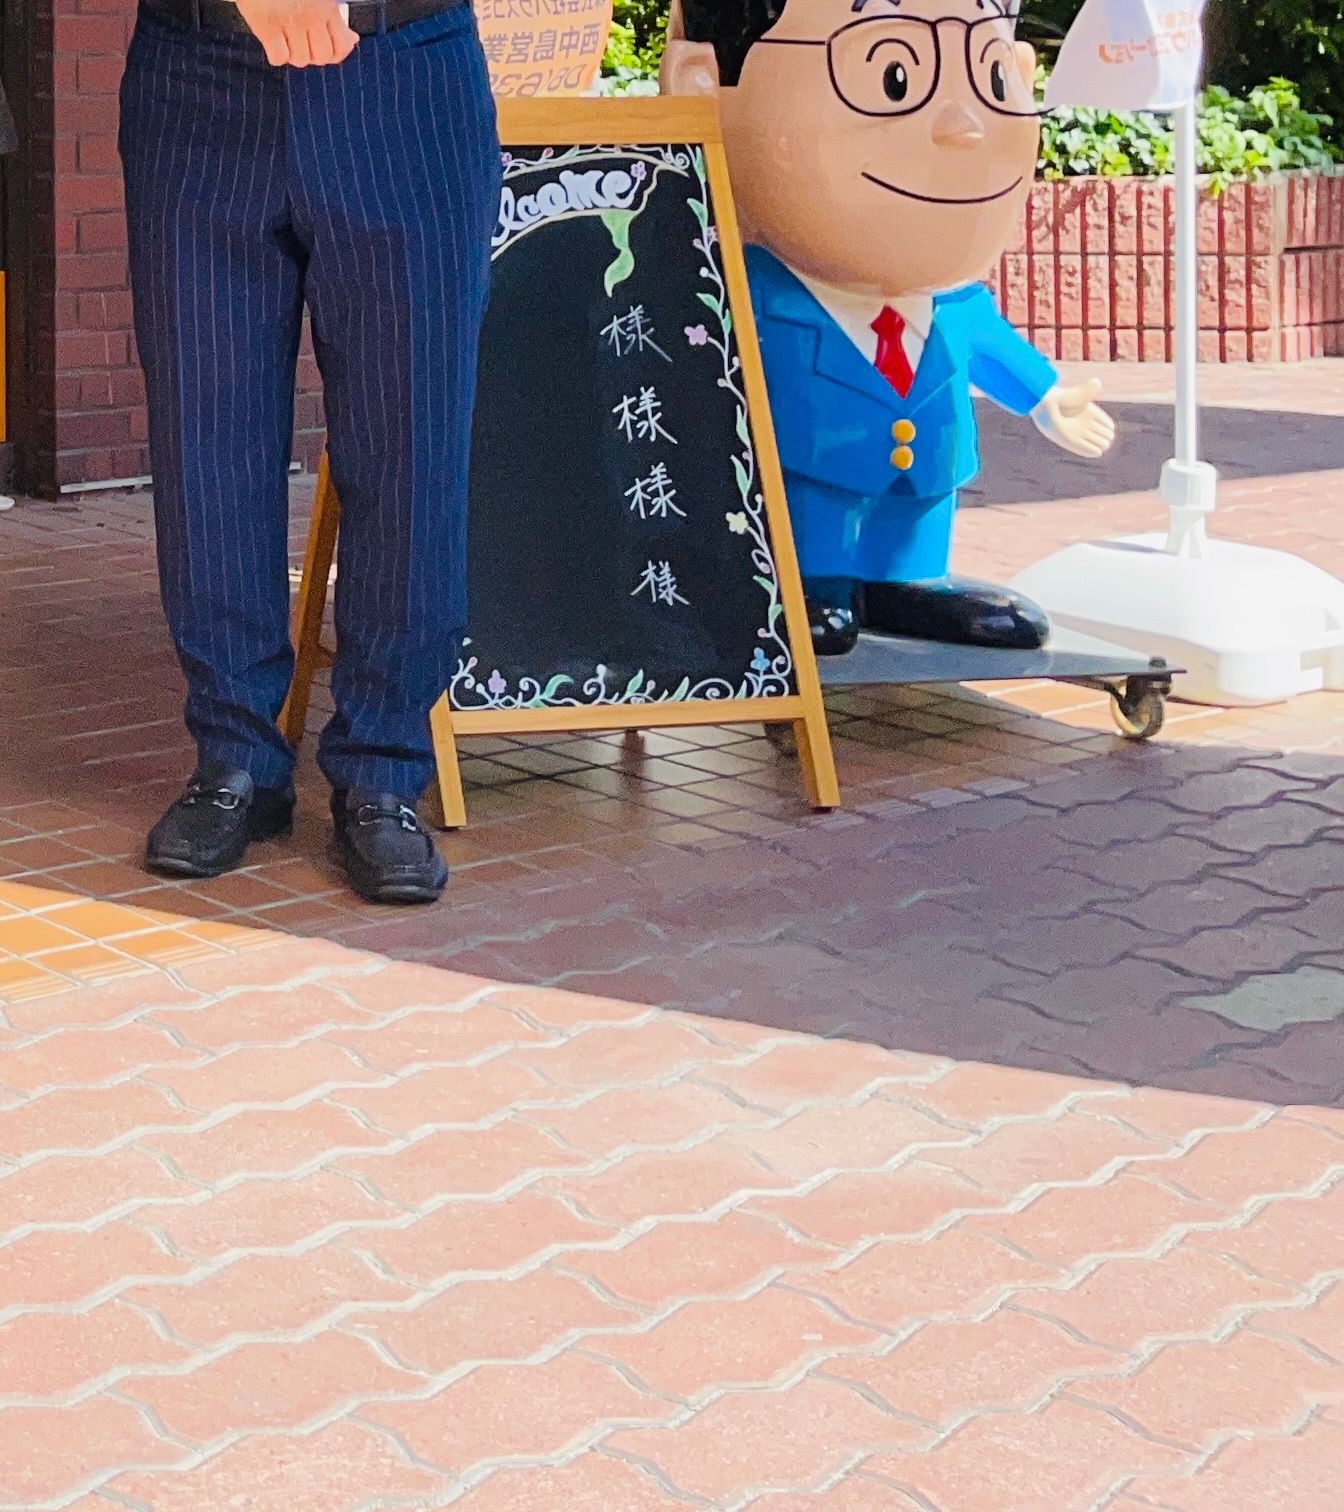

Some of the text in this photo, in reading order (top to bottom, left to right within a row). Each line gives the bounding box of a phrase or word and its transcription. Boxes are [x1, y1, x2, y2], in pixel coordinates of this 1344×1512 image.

[490, 169, 644, 248] lcome
[600, 303, 674, 364] 様
[611, 385, 679, 446] 様
[623, 462, 688, 521] 様
[630, 560, 690, 607] 様
